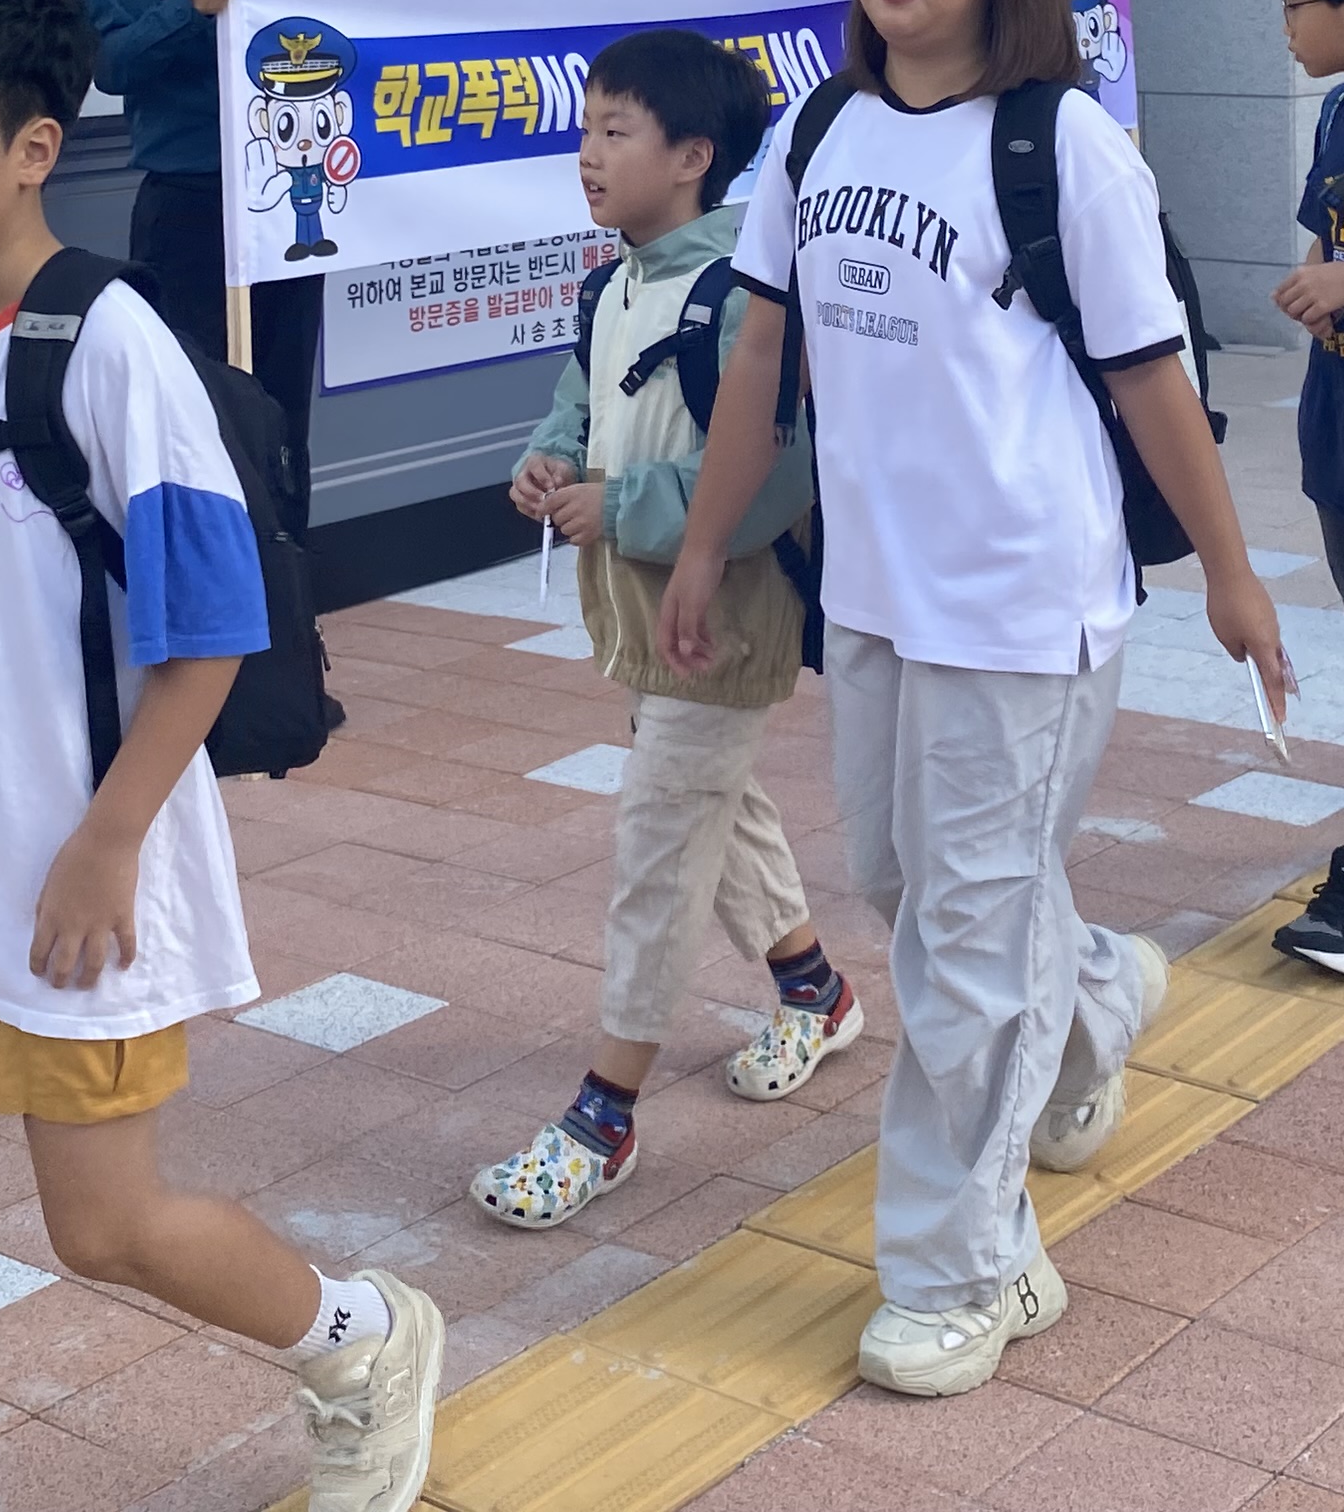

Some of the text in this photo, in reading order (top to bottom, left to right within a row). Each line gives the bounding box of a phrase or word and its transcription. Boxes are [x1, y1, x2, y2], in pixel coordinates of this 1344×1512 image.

[798, 185, 959, 282] BROOKLYN
[347, 276, 402, 309] 위하여
[410, 272, 445, 300] 본교
[452, 259, 521, 293] 방문자는
[528, 250, 576, 282] 반드시
[843, 264, 885, 289] URBAN
[409, 297, 480, 333] 방문증을
[487, 284, 553, 320] 발급받아
[856, 309, 919, 346] LEAGUE
